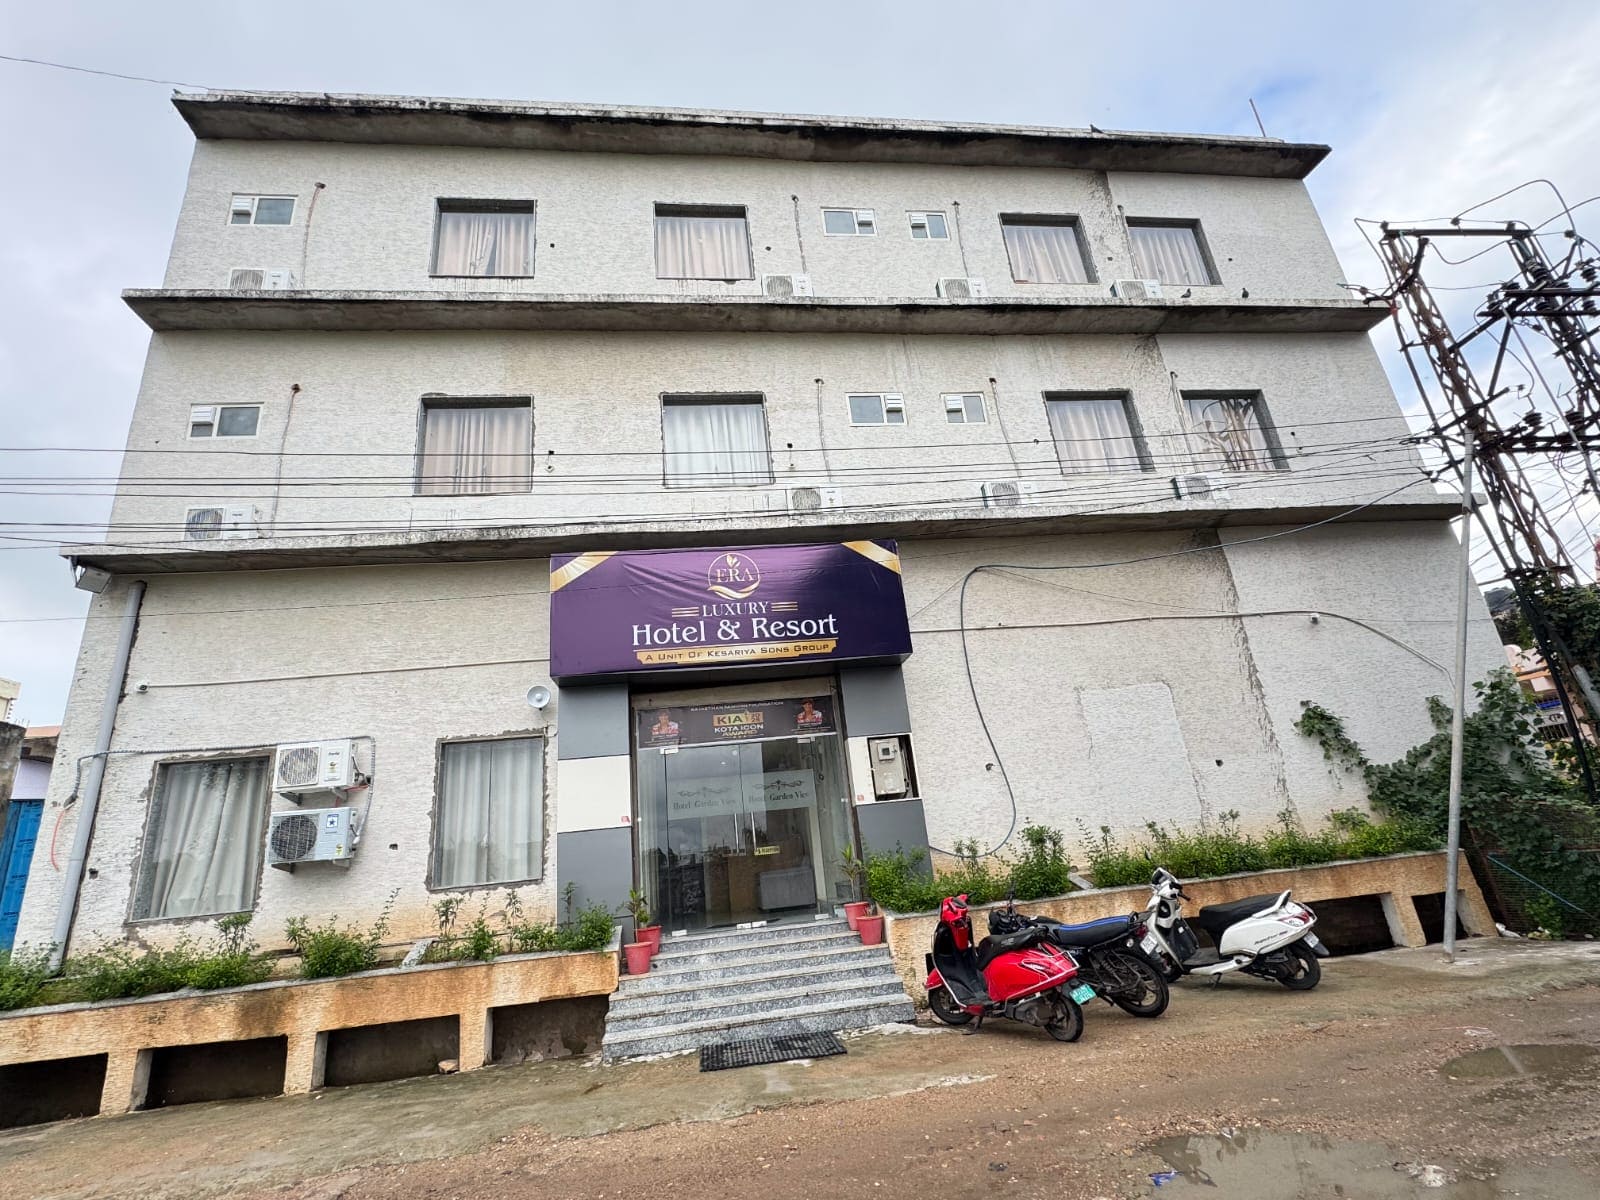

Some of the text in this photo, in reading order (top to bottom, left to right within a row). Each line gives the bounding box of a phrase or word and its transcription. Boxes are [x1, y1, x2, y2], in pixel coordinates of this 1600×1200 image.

[716, 568, 755, 583] ERA
[702, 601, 769, 617] LUXURY
[632, 613, 839, 646] Hotel & Resort
[645, 653, 654, 662] A
[707, 648, 756, 658] KESARIYA
[760, 646, 790, 654] SONS
[794, 643, 830, 653] GROUP
[717, 714, 743, 725] KIA
[714, 723, 764, 734] KOTA ICON
[722, 729, 758, 737] AWARD
